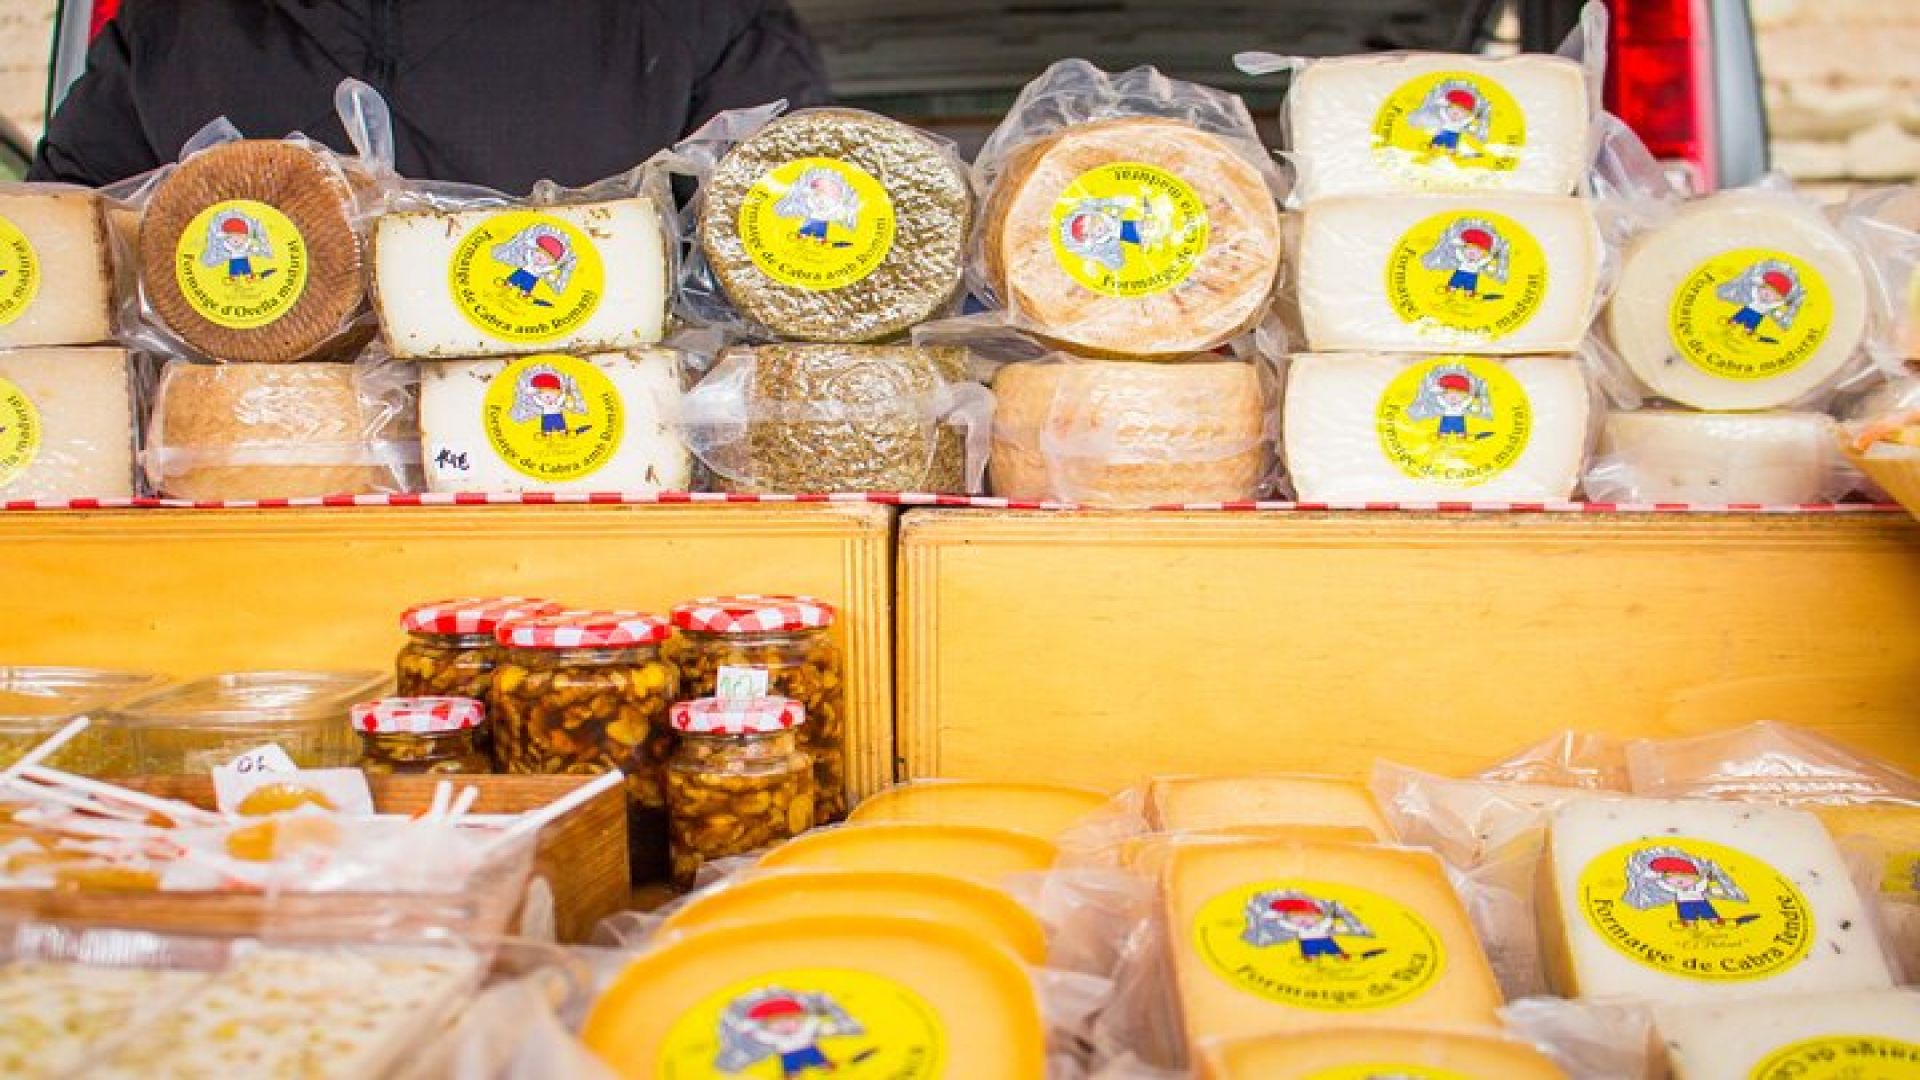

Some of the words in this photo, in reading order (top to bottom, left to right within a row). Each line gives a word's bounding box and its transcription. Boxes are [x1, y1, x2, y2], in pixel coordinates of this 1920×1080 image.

[1114, 170, 1183, 199] madurat
[12, 240, 31, 298] madurat
[183, 253, 220, 310] Formatge
[277, 240, 300, 298] madurat
[456, 230, 494, 285] Formatge
[761, 251, 776, 265] de
[777, 262, 823, 281] Cabra
[461, 287, 476, 303] de
[474, 304, 513, 332] Cabra
[1495, 273, 1540, 328] madurat
[1679, 271, 1716, 335] Formatge
[514, 322, 550, 334] amb
[1687, 339, 1706, 354] de
[1759, 328, 1820, 371] madurat
[1705, 352, 1754, 372] Cabra
[7, 395, 30, 453] madurat
[489, 404, 521, 459] Formatge
[519, 457, 537, 469] de
[538, 461, 581, 474] Cabra
[583, 441, 607, 465] amb
[1386, 404, 1417, 466] Formatge
[1444, 463, 1493, 480] Cabra
[1493, 406, 1525, 464] madurat
[1594, 898, 1676, 963] Formatge
[1682, 957, 1713, 971] de
[1719, 946, 1786, 972] Cabra
[1236, 964, 1362, 1003] Formatge
[1367, 982, 1394, 997] de
